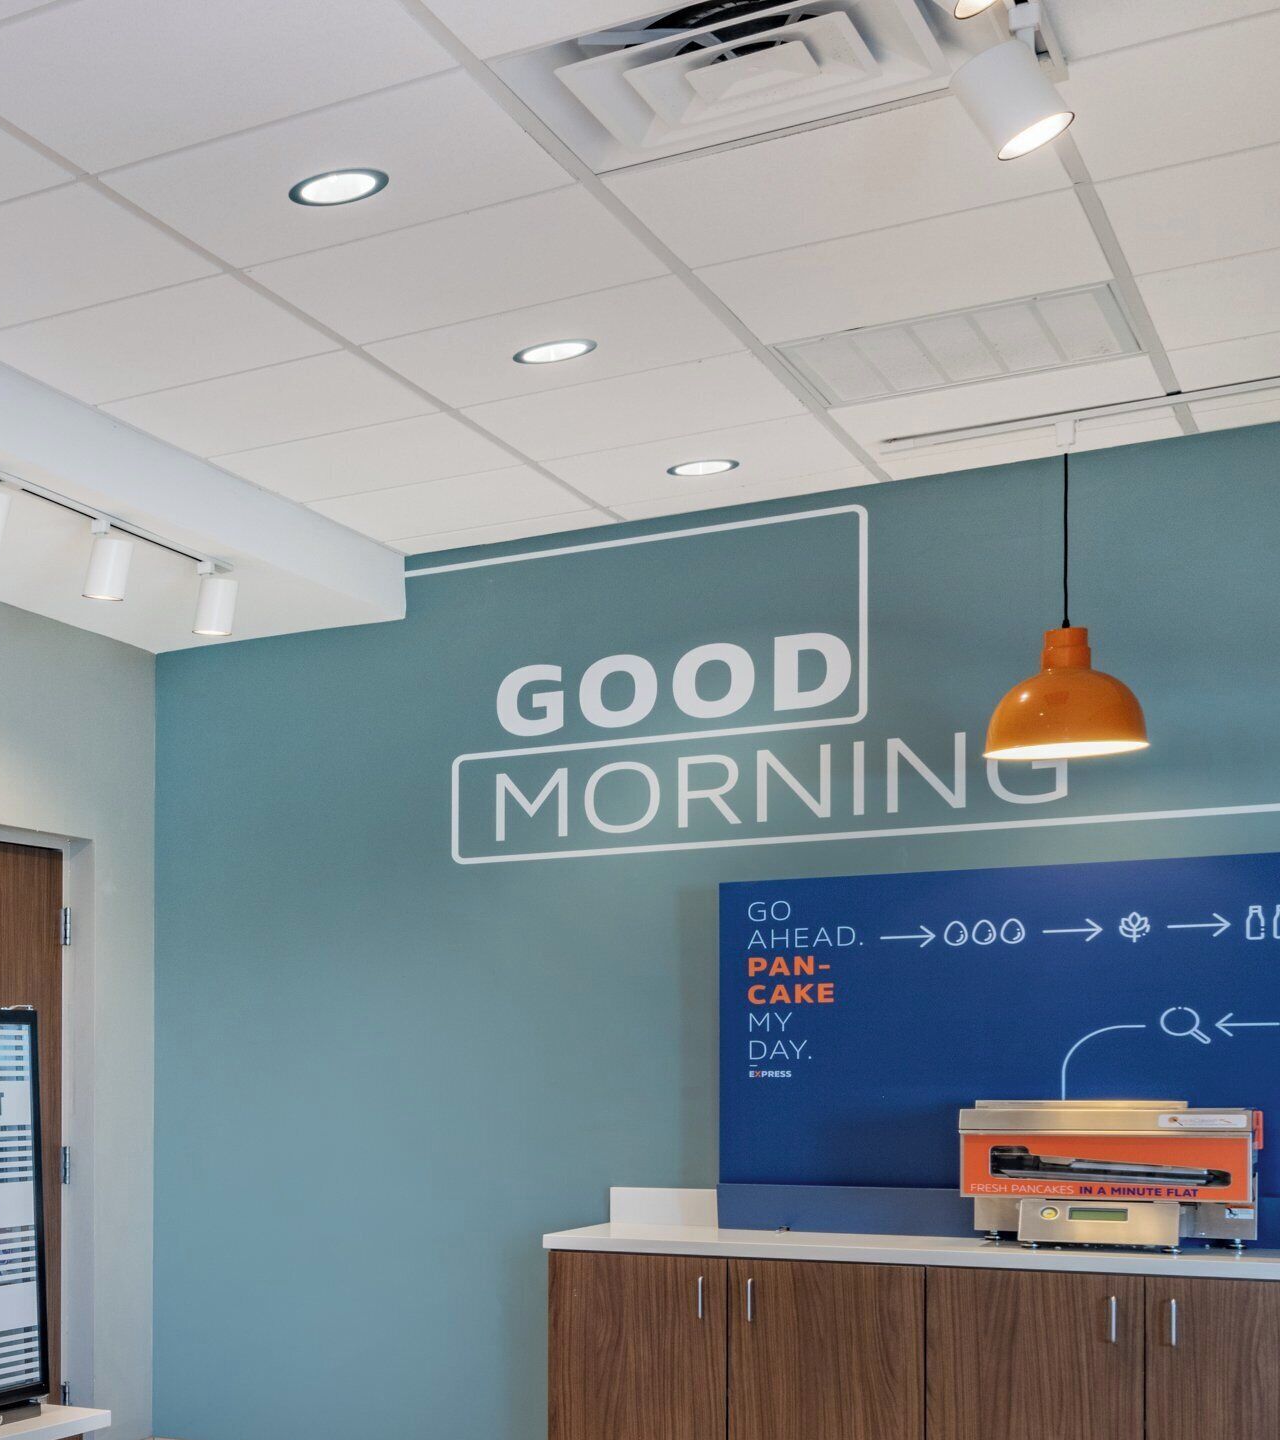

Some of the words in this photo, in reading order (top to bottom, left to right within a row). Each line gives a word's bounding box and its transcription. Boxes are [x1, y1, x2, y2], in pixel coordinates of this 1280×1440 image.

[495, 632, 853, 737] GOOD
[494, 731, 1070, 842] MORNING
[747, 900, 791, 922] GO
[747, 926, 864, 950] AHEAD.
[747, 955, 831, 977] PAN-
[747, 983, 835, 1005] CAKE
[748, 1011, 793, 1033] MY
[748, 1039, 813, 1060] DAY.
[748, 1070, 792, 1078] EXPRESS
[970, 1183, 1009, 1194] FRESH
[1011, 1184, 1074, 1195] PANCAKES
[1079, 1186, 1093, 1195] IN
[1097, 1186, 1108, 1196] A
[1110, 1187, 1163, 1197] MINUTE
[1166, 1188, 1199, 1198] FLAT
